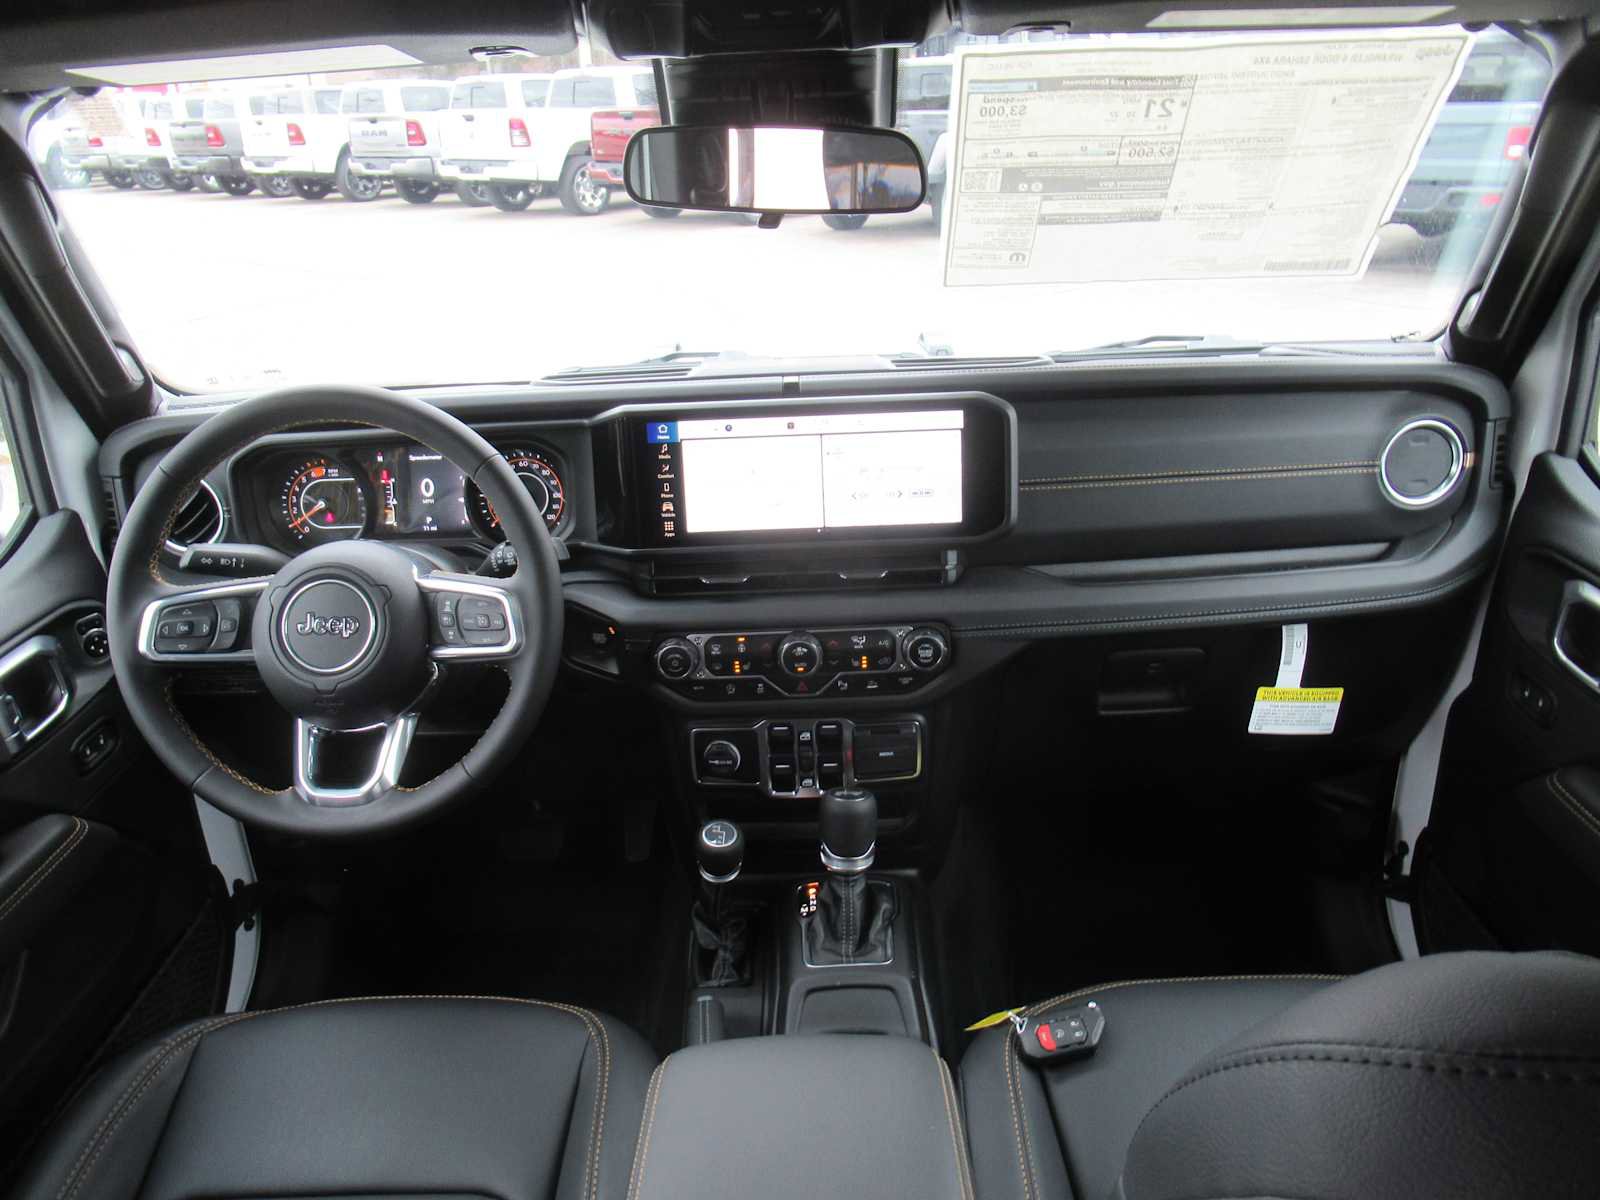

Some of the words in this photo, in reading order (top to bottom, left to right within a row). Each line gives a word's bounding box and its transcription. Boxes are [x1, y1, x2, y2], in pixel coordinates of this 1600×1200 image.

[361, 129, 388, 137] RAM
[421, 478, 435, 498] 0
[296, 612, 360, 638] Jeep
